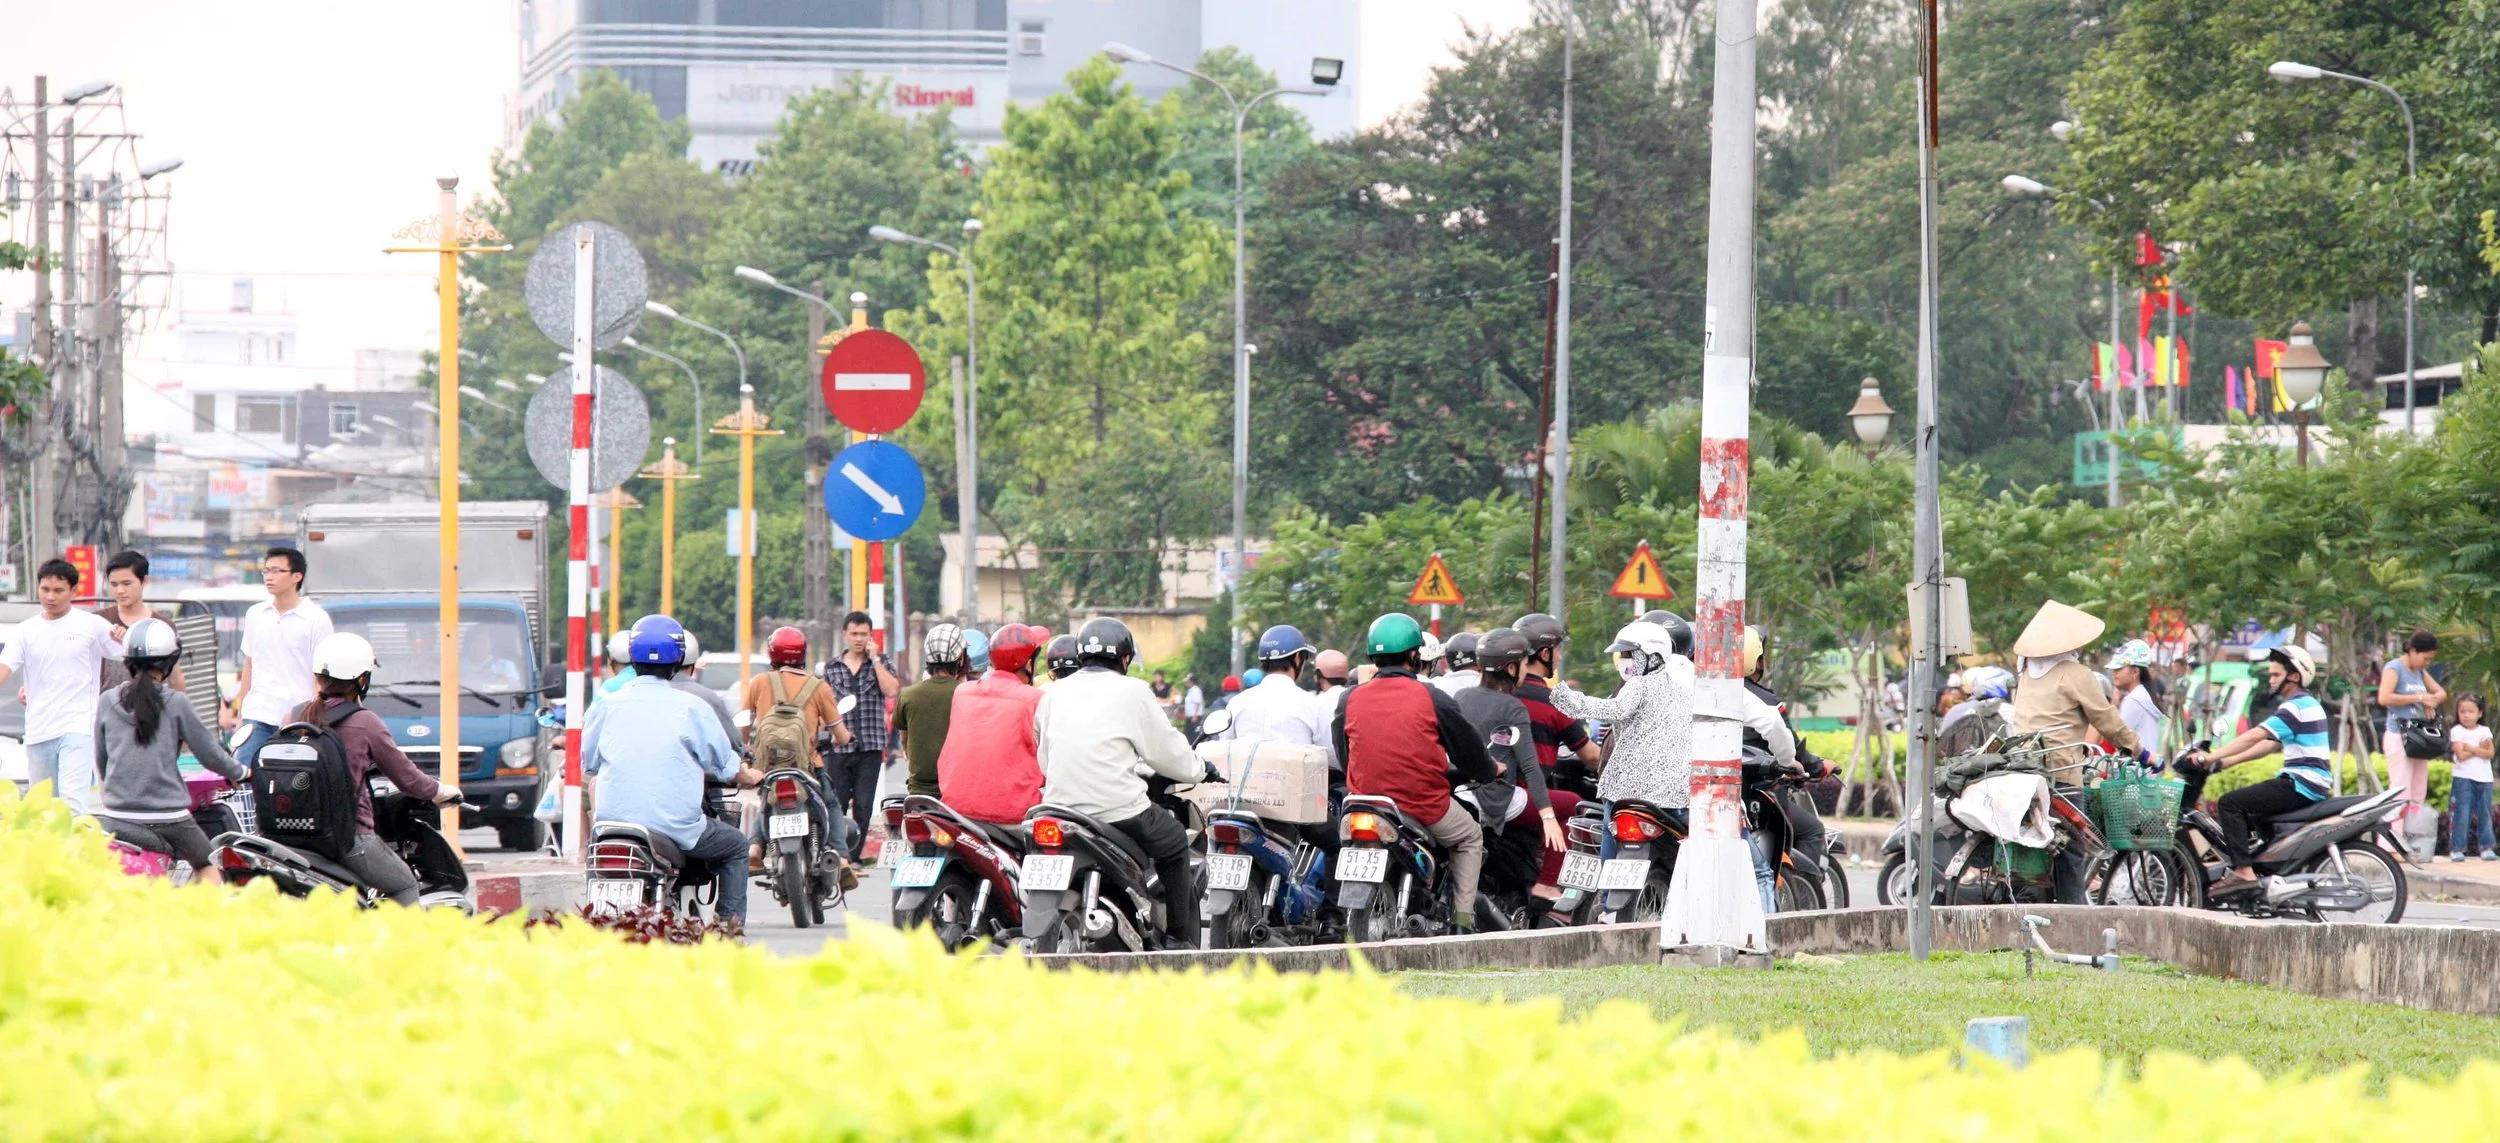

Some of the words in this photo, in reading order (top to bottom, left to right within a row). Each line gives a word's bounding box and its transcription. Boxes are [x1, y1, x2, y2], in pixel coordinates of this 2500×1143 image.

[1346, 851, 1380, 864] 51-X5
[1568, 855, 1599, 872] 76-V3
[1030, 858, 1063, 872] 55-X1
[1344, 865, 1378, 879] 4427
[1610, 862, 1642, 875] 77-X2
[1027, 873, 1062, 887] 5357
[1208, 872, 1241, 886] 3590
[1564, 870, 1593, 887] 3650
[1605, 875, 1639, 886] 8657
